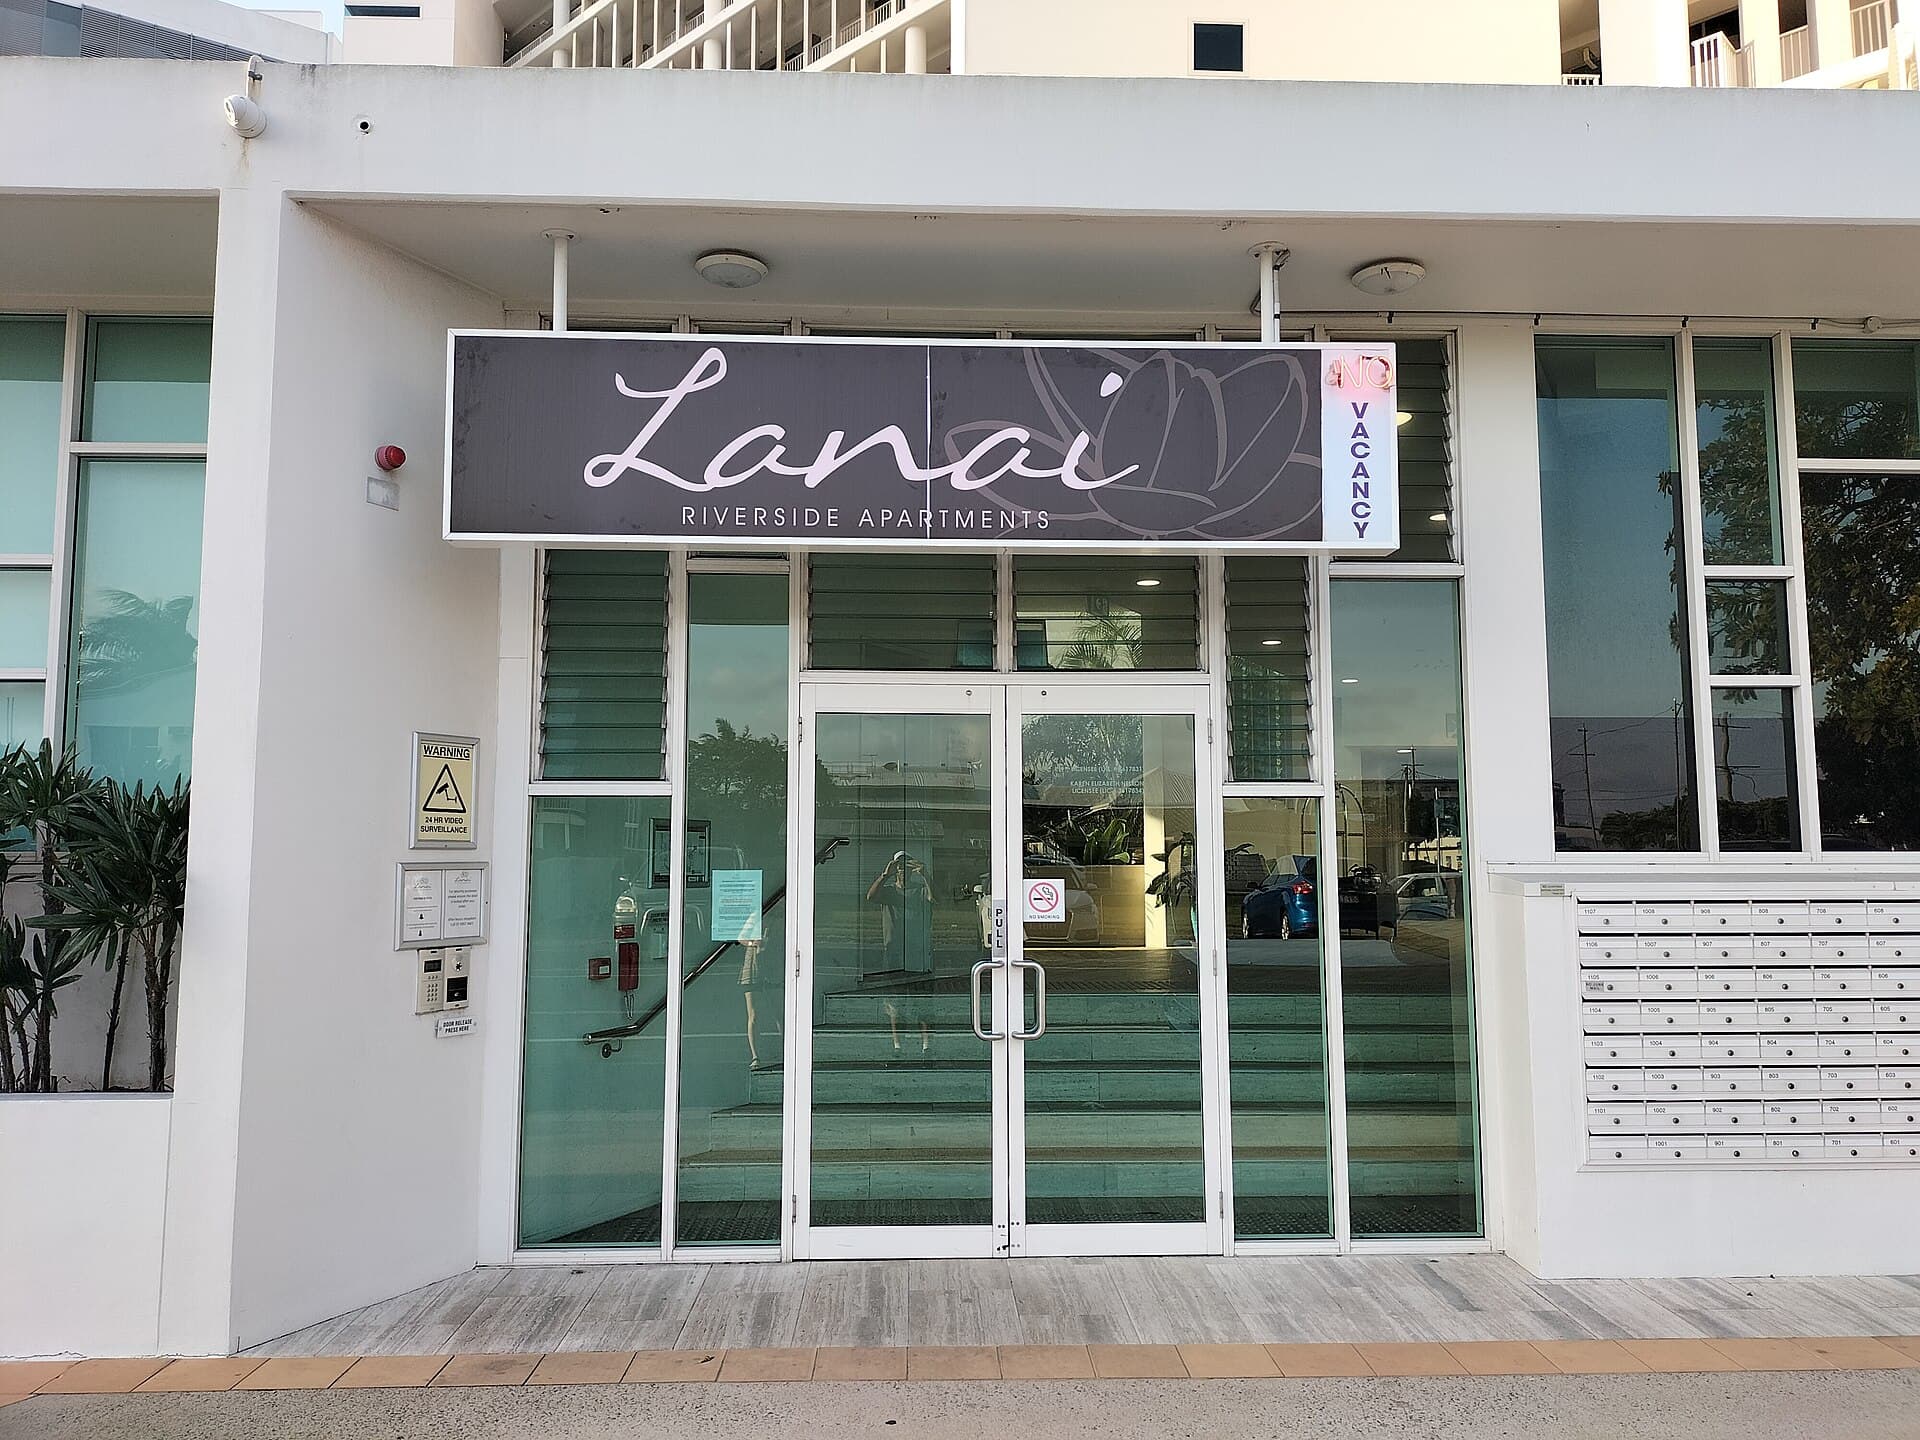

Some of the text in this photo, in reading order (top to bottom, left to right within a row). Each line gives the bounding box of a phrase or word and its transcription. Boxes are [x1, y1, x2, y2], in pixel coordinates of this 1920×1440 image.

[1339, 355, 1393, 389] NO
[583, 346, 1140, 492] Lanai
[1350, 402, 1372, 539] VACANCY
[681, 506, 1050, 530] RIVERSIDE APARTMENTS
[423, 744, 470, 759] WARNING
[420, 825, 468, 834] SURVEILLANCE
[425, 816, 464, 825] 24 HR VIDEO
[995, 908, 1003, 949] PULL
